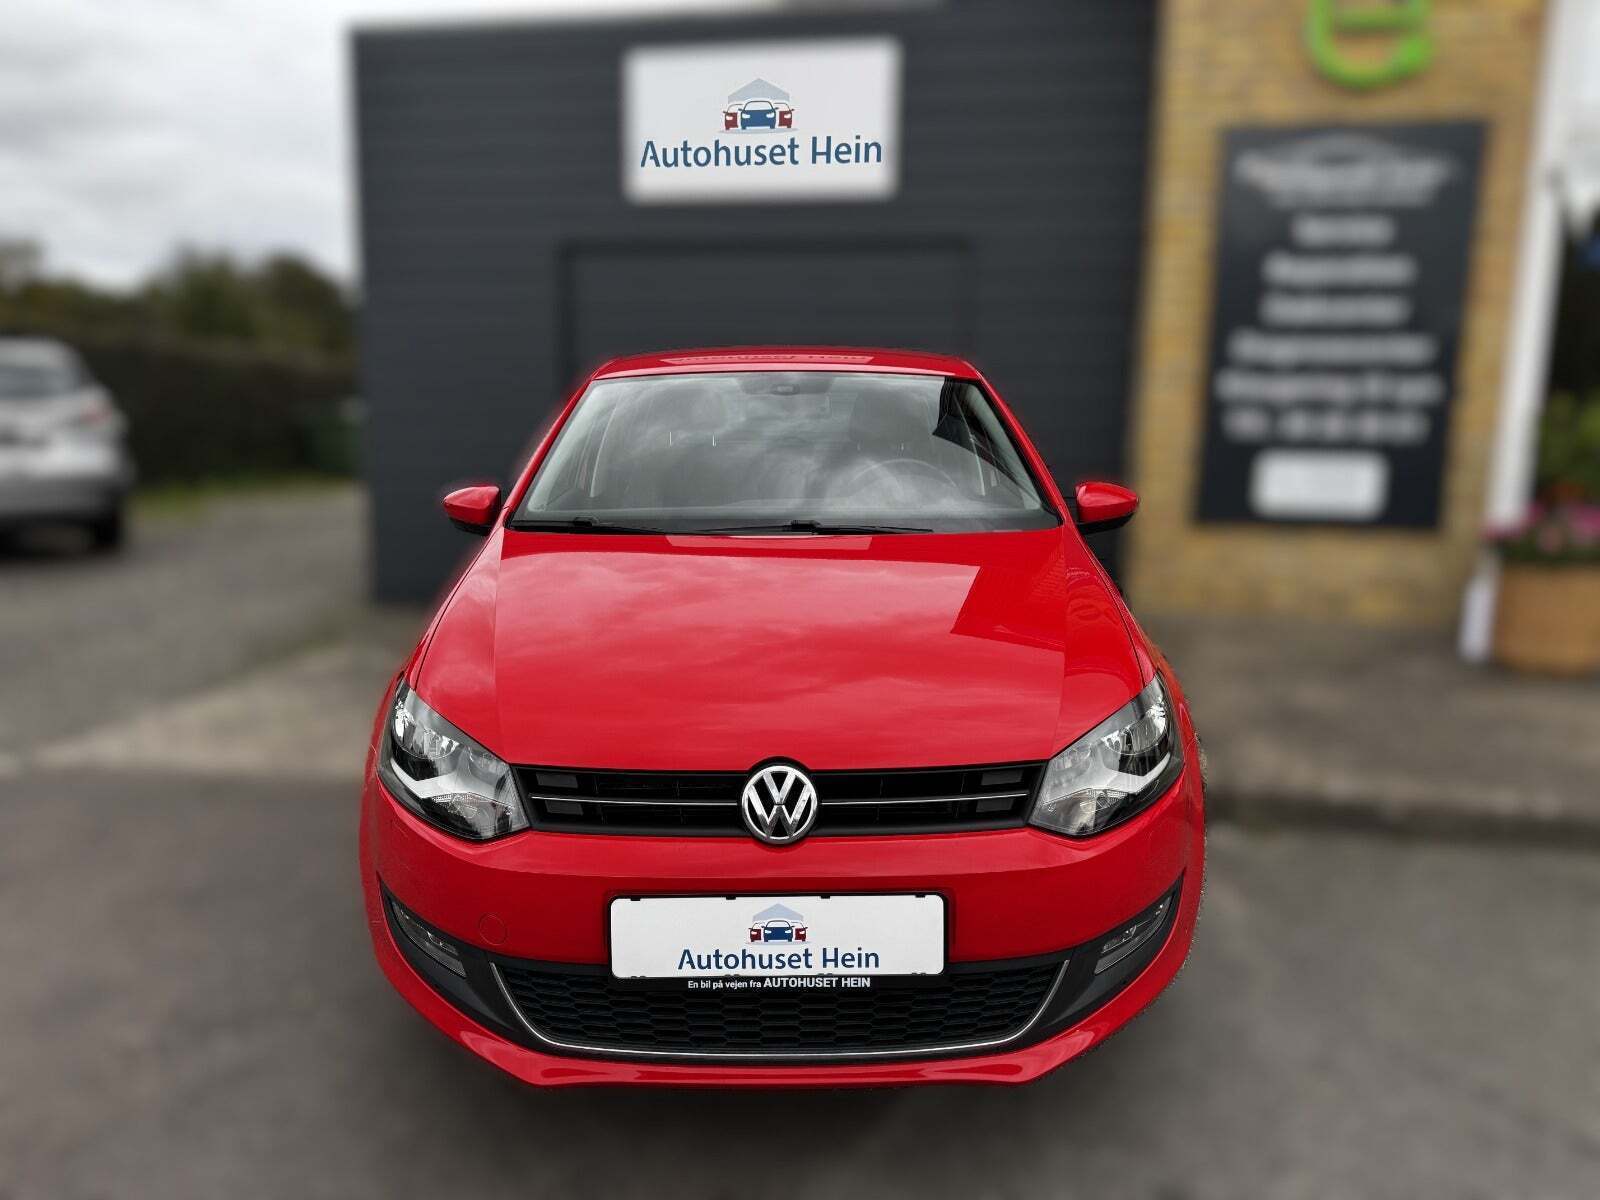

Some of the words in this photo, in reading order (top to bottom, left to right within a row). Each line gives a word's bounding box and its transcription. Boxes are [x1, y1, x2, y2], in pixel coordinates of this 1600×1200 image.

[640, 137, 799, 168] Autohuset
[811, 134, 882, 165] Hein
[677, 948, 813, 970] Autohuset
[822, 946, 880, 969] Hein
[687, 980, 699, 989] En
[700, 979, 711, 989] bil
[725, 980, 748, 990] vejen
[749, 979, 762, 988] fra
[763, 976, 839, 988] AUTOHUSET
[841, 976, 871, 988] HEIN
